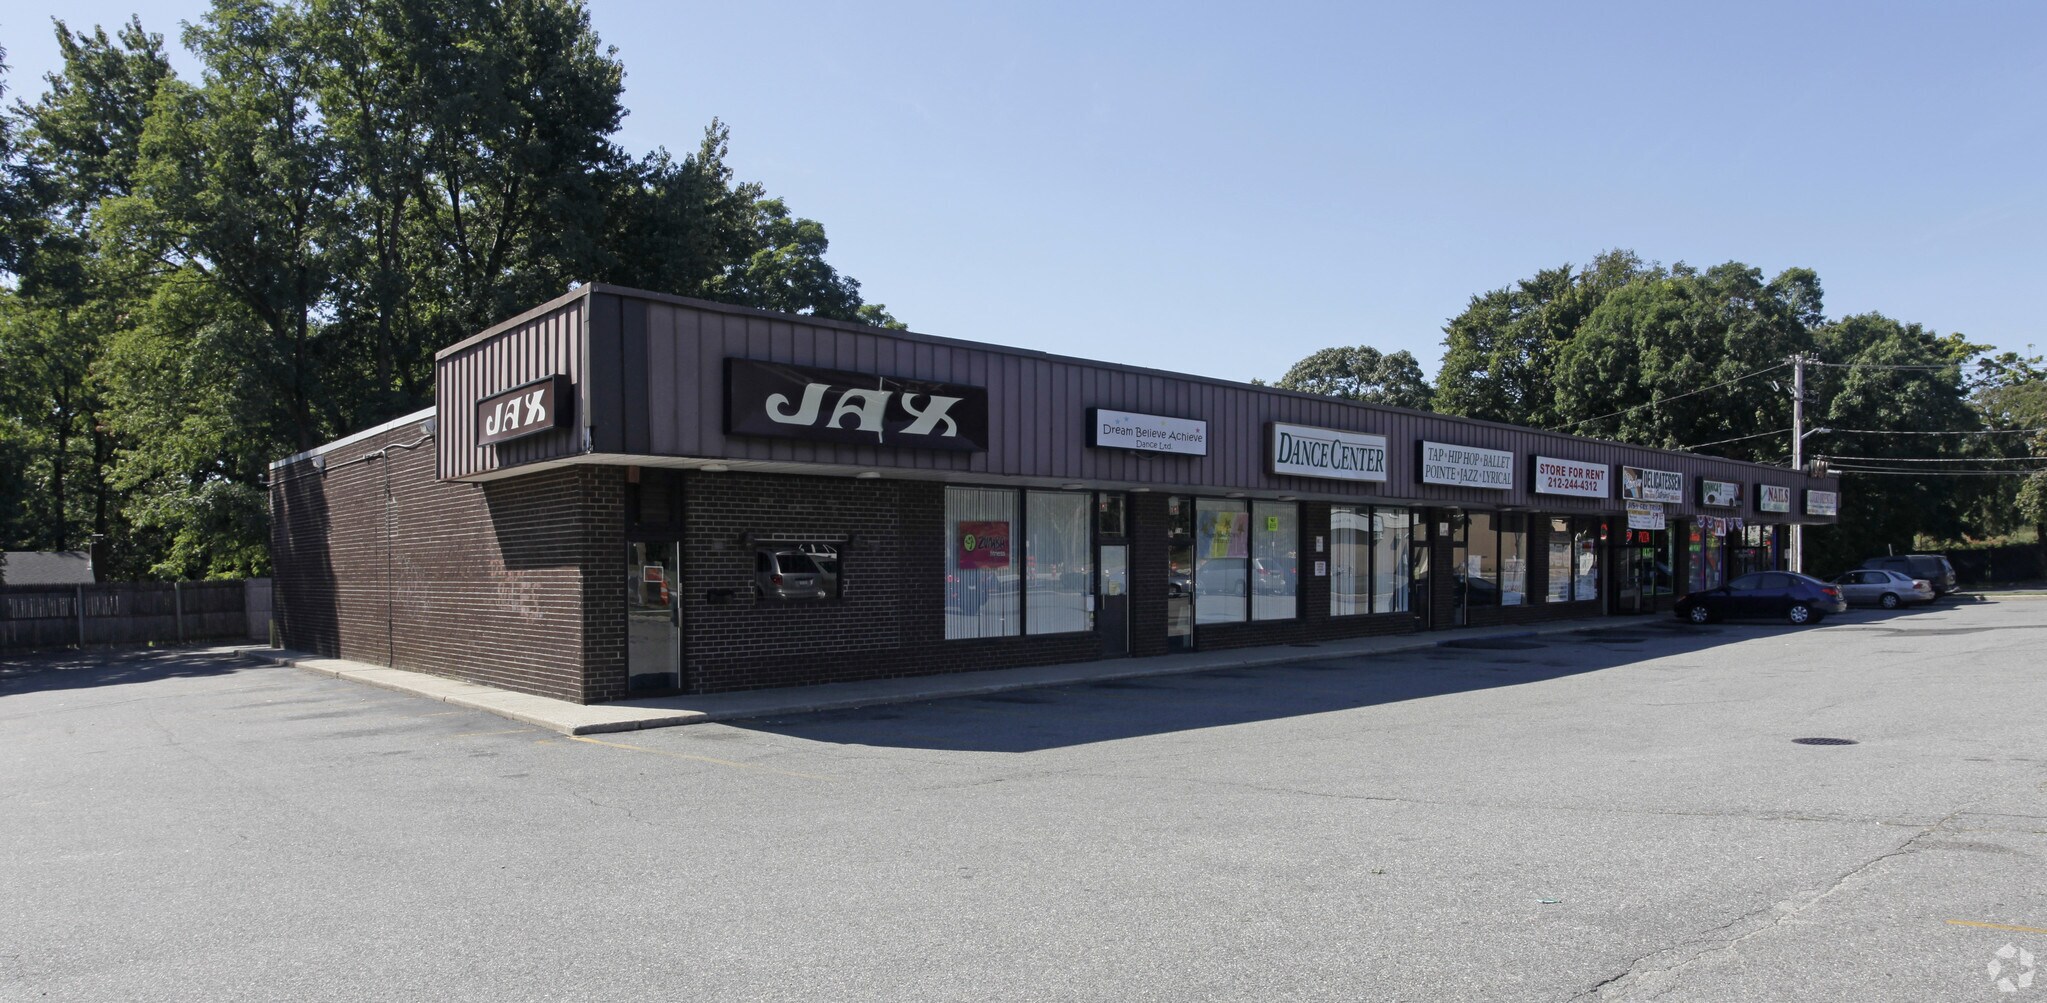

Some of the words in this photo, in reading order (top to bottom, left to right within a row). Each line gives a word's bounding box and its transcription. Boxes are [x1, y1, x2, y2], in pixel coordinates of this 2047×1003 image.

[486, 389, 546, 436] JAX
[766, 383, 964, 437] JAX
[1103, 423, 1133, 436] Dream
[1136, 427, 1166, 439] Believe
[1168, 430, 1203, 442] Achieve
[1136, 440, 1158, 449] Dance
[1159, 442, 1173, 450] Ltd.
[1277, 432, 1329, 468] DANCE
[1331, 439, 1384, 472] CENTER
[1428, 447, 1444, 462] TAP
[1448, 450, 1463, 464] HIP
[1463, 452, 1480, 466] HOP
[1483, 454, 1511, 469] BALLET
[1425, 464, 1456, 480] POINTE
[1459, 468, 1478, 484] JAZZ
[1482, 470, 1511, 485] LYRICAL
[1540, 464, 1566, 477] STORE
[1568, 467, 1584, 479] FOR
[1585, 469, 1605, 480] RENT
[1644, 471, 1682, 491] DELICATESSEN
[1548, 477, 1598, 491] 212-244-4312
[1768, 487, 1789, 503] NAILS
